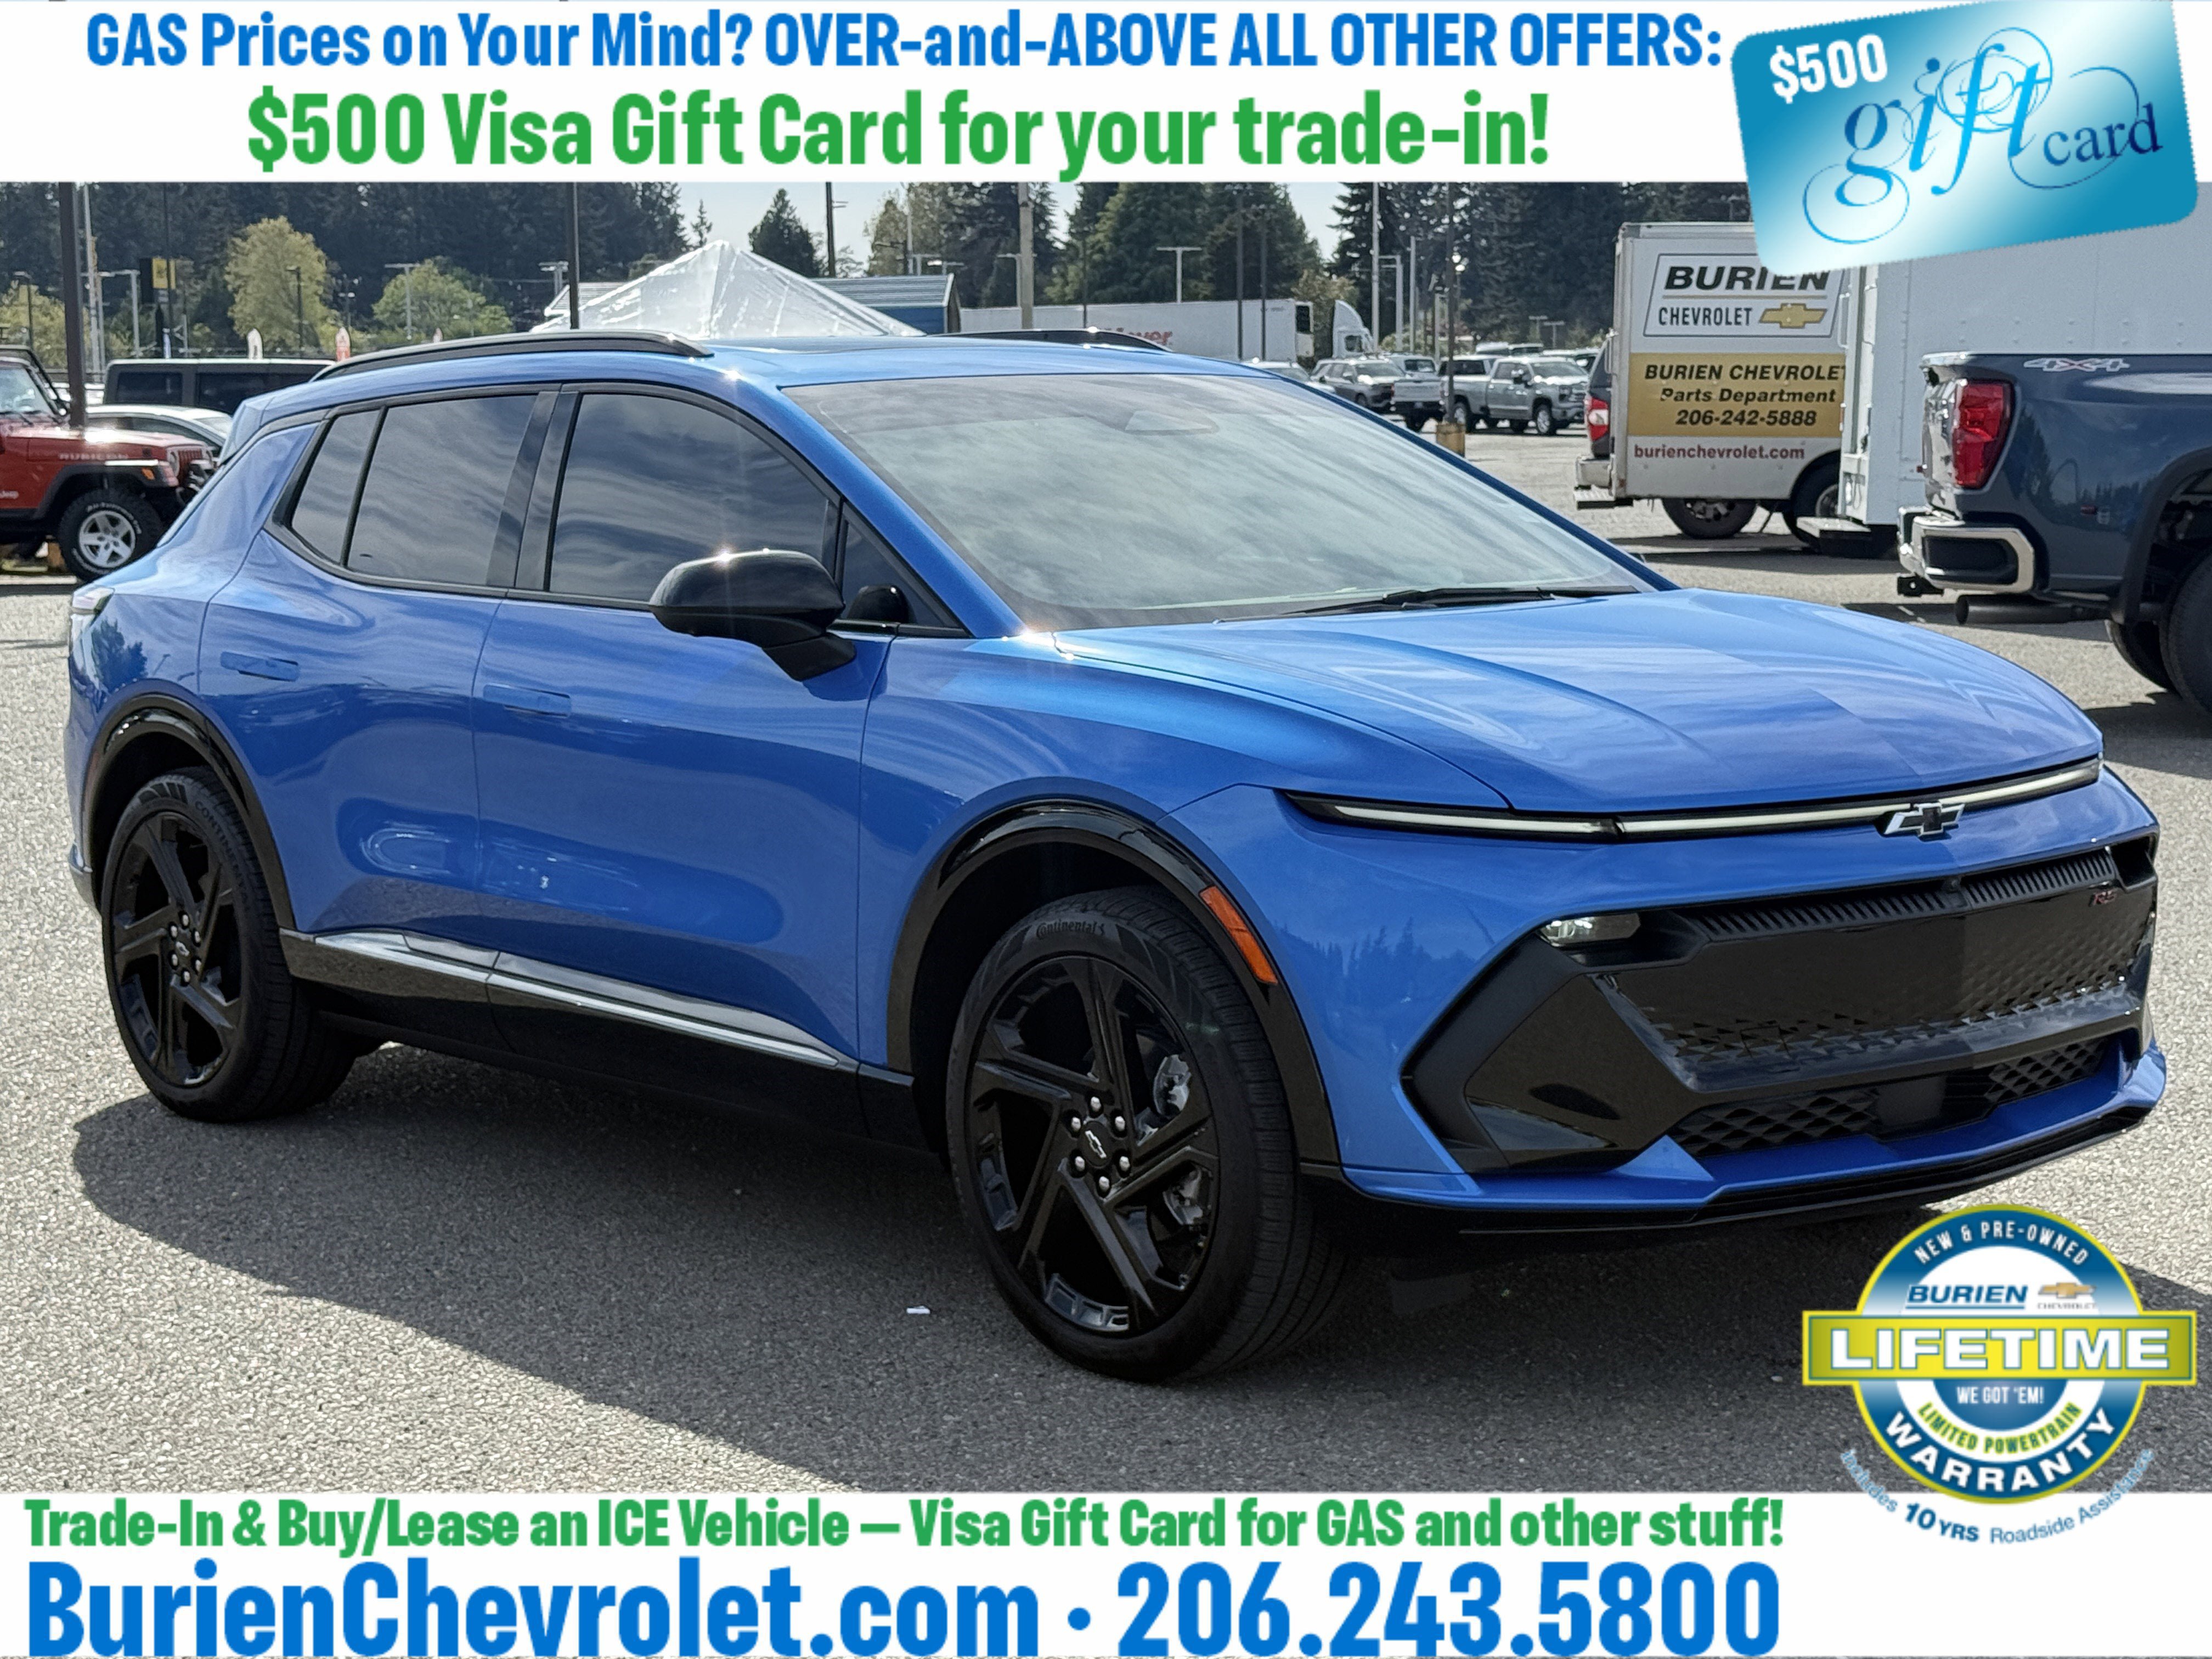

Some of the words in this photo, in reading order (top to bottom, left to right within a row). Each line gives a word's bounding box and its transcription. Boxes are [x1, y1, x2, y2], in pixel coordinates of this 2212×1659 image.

[1664, 266, 1830, 290] BURIEN
[1658, 307, 1752, 326] CHEVROLET
[1645, 364, 1723, 380] BURIEN
[1660, 388, 1713, 402] Parts
[1718, 388, 1836, 405] Department
[1675, 409, 1818, 427] 206-242-5888
[1634, 444, 1805, 460] burienchevrolet.com
